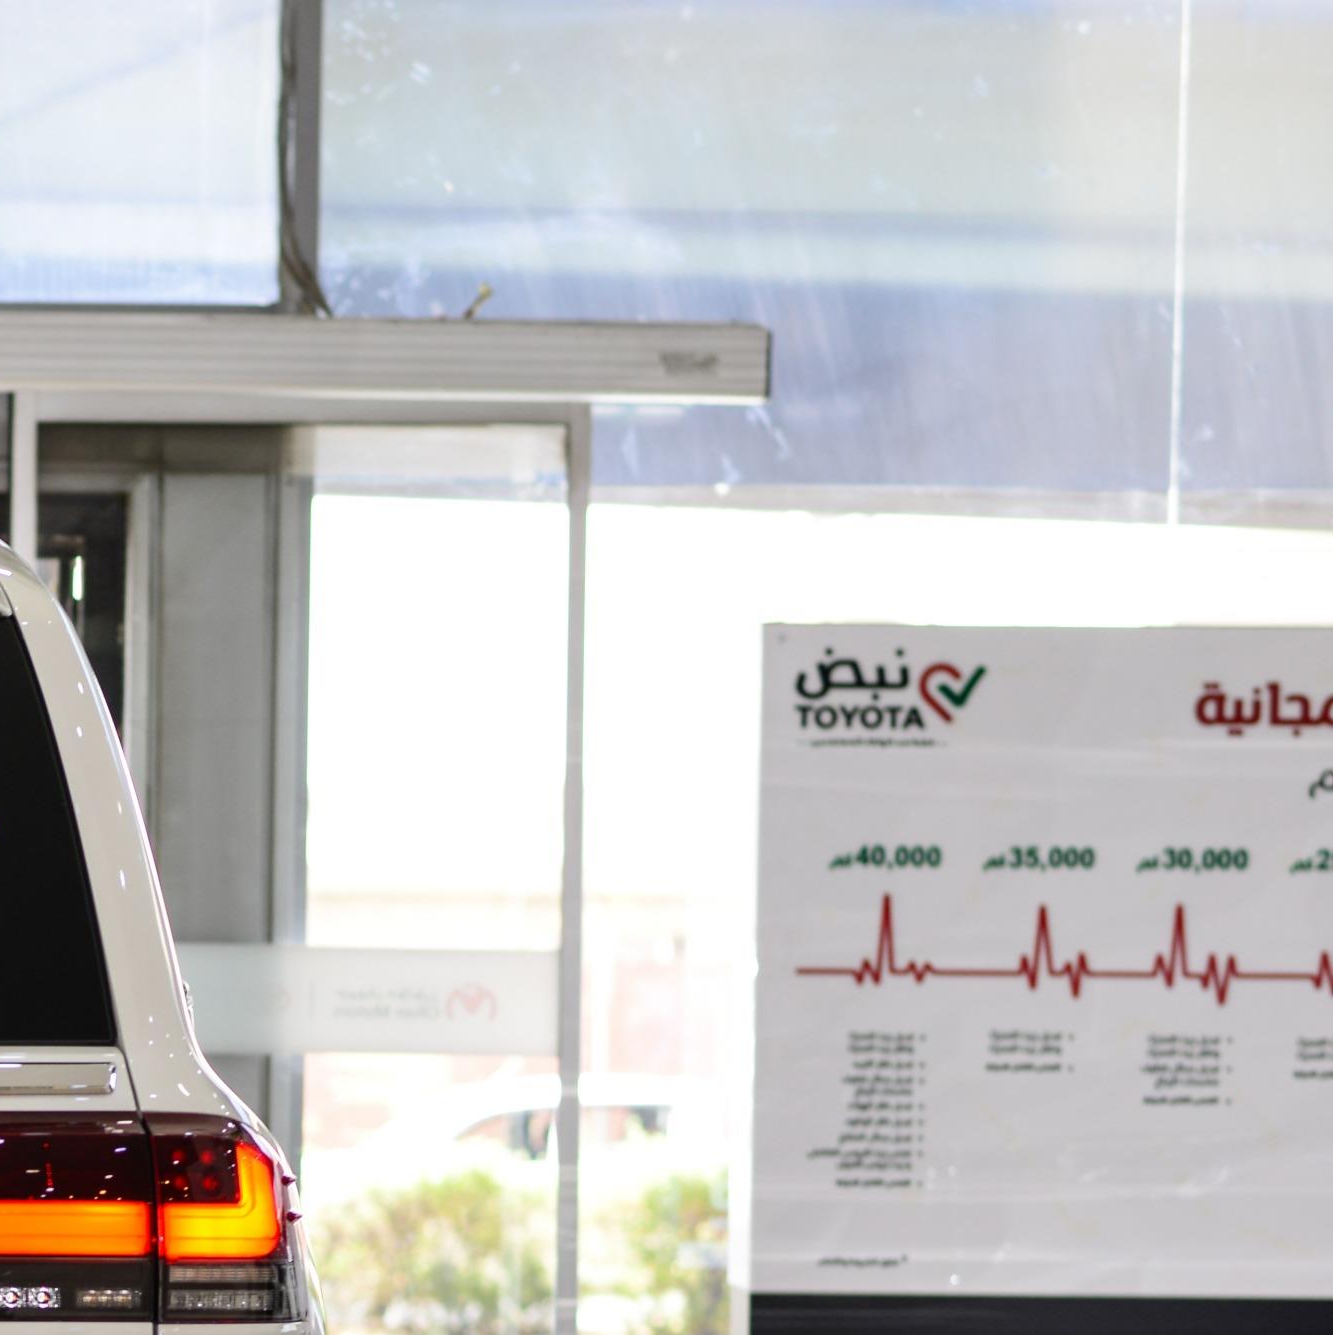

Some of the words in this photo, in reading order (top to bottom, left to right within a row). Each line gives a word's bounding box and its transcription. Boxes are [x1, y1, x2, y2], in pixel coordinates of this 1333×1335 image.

[795, 647, 910, 701] نبض
[795, 704, 925, 730] TOYOTA
[855, 844, 942, 870] 40,000
[1009, 846, 1096, 871] 35,000
[1162, 847, 1250, 872] 30,000
